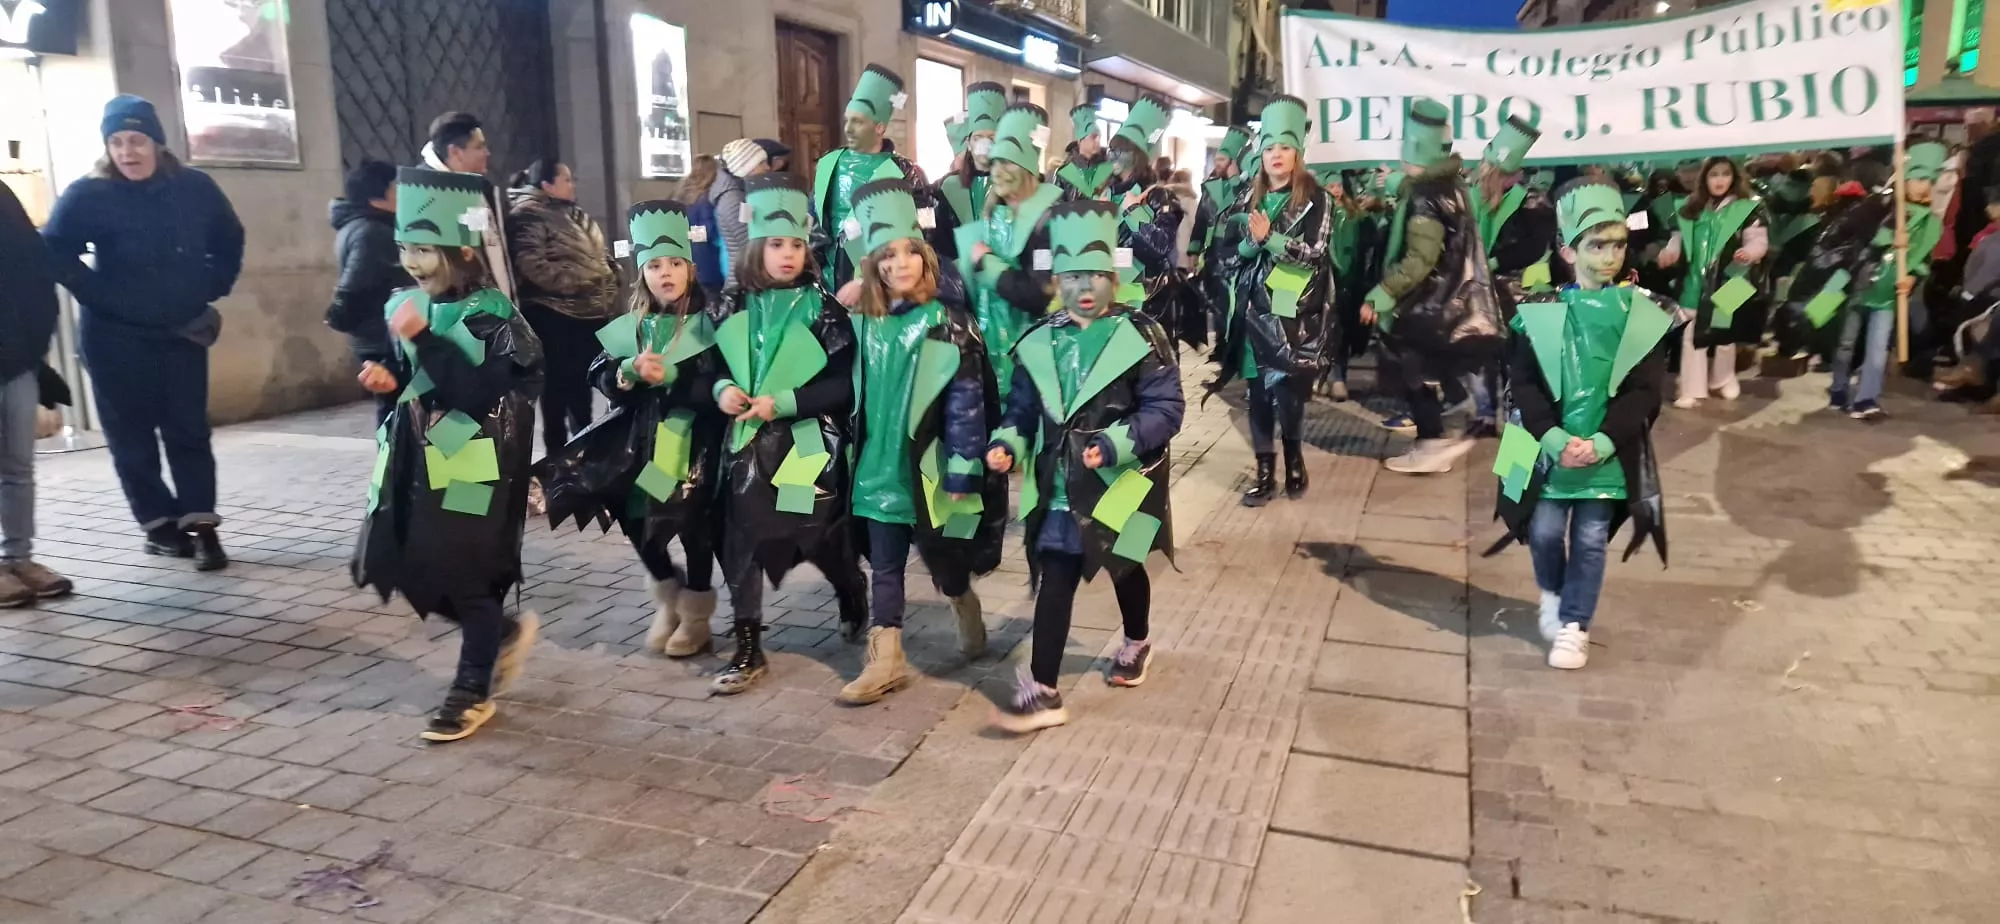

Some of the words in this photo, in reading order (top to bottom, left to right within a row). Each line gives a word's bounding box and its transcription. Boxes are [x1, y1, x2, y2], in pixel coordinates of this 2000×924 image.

[1304, 32, 1433, 70] A.P.A.
[1486, 43, 1662, 82] Colegio
[1683, 3, 1890, 62] Público
[1563, 93, 1612, 141] J.
[1638, 64, 1879, 131] RUBIO
